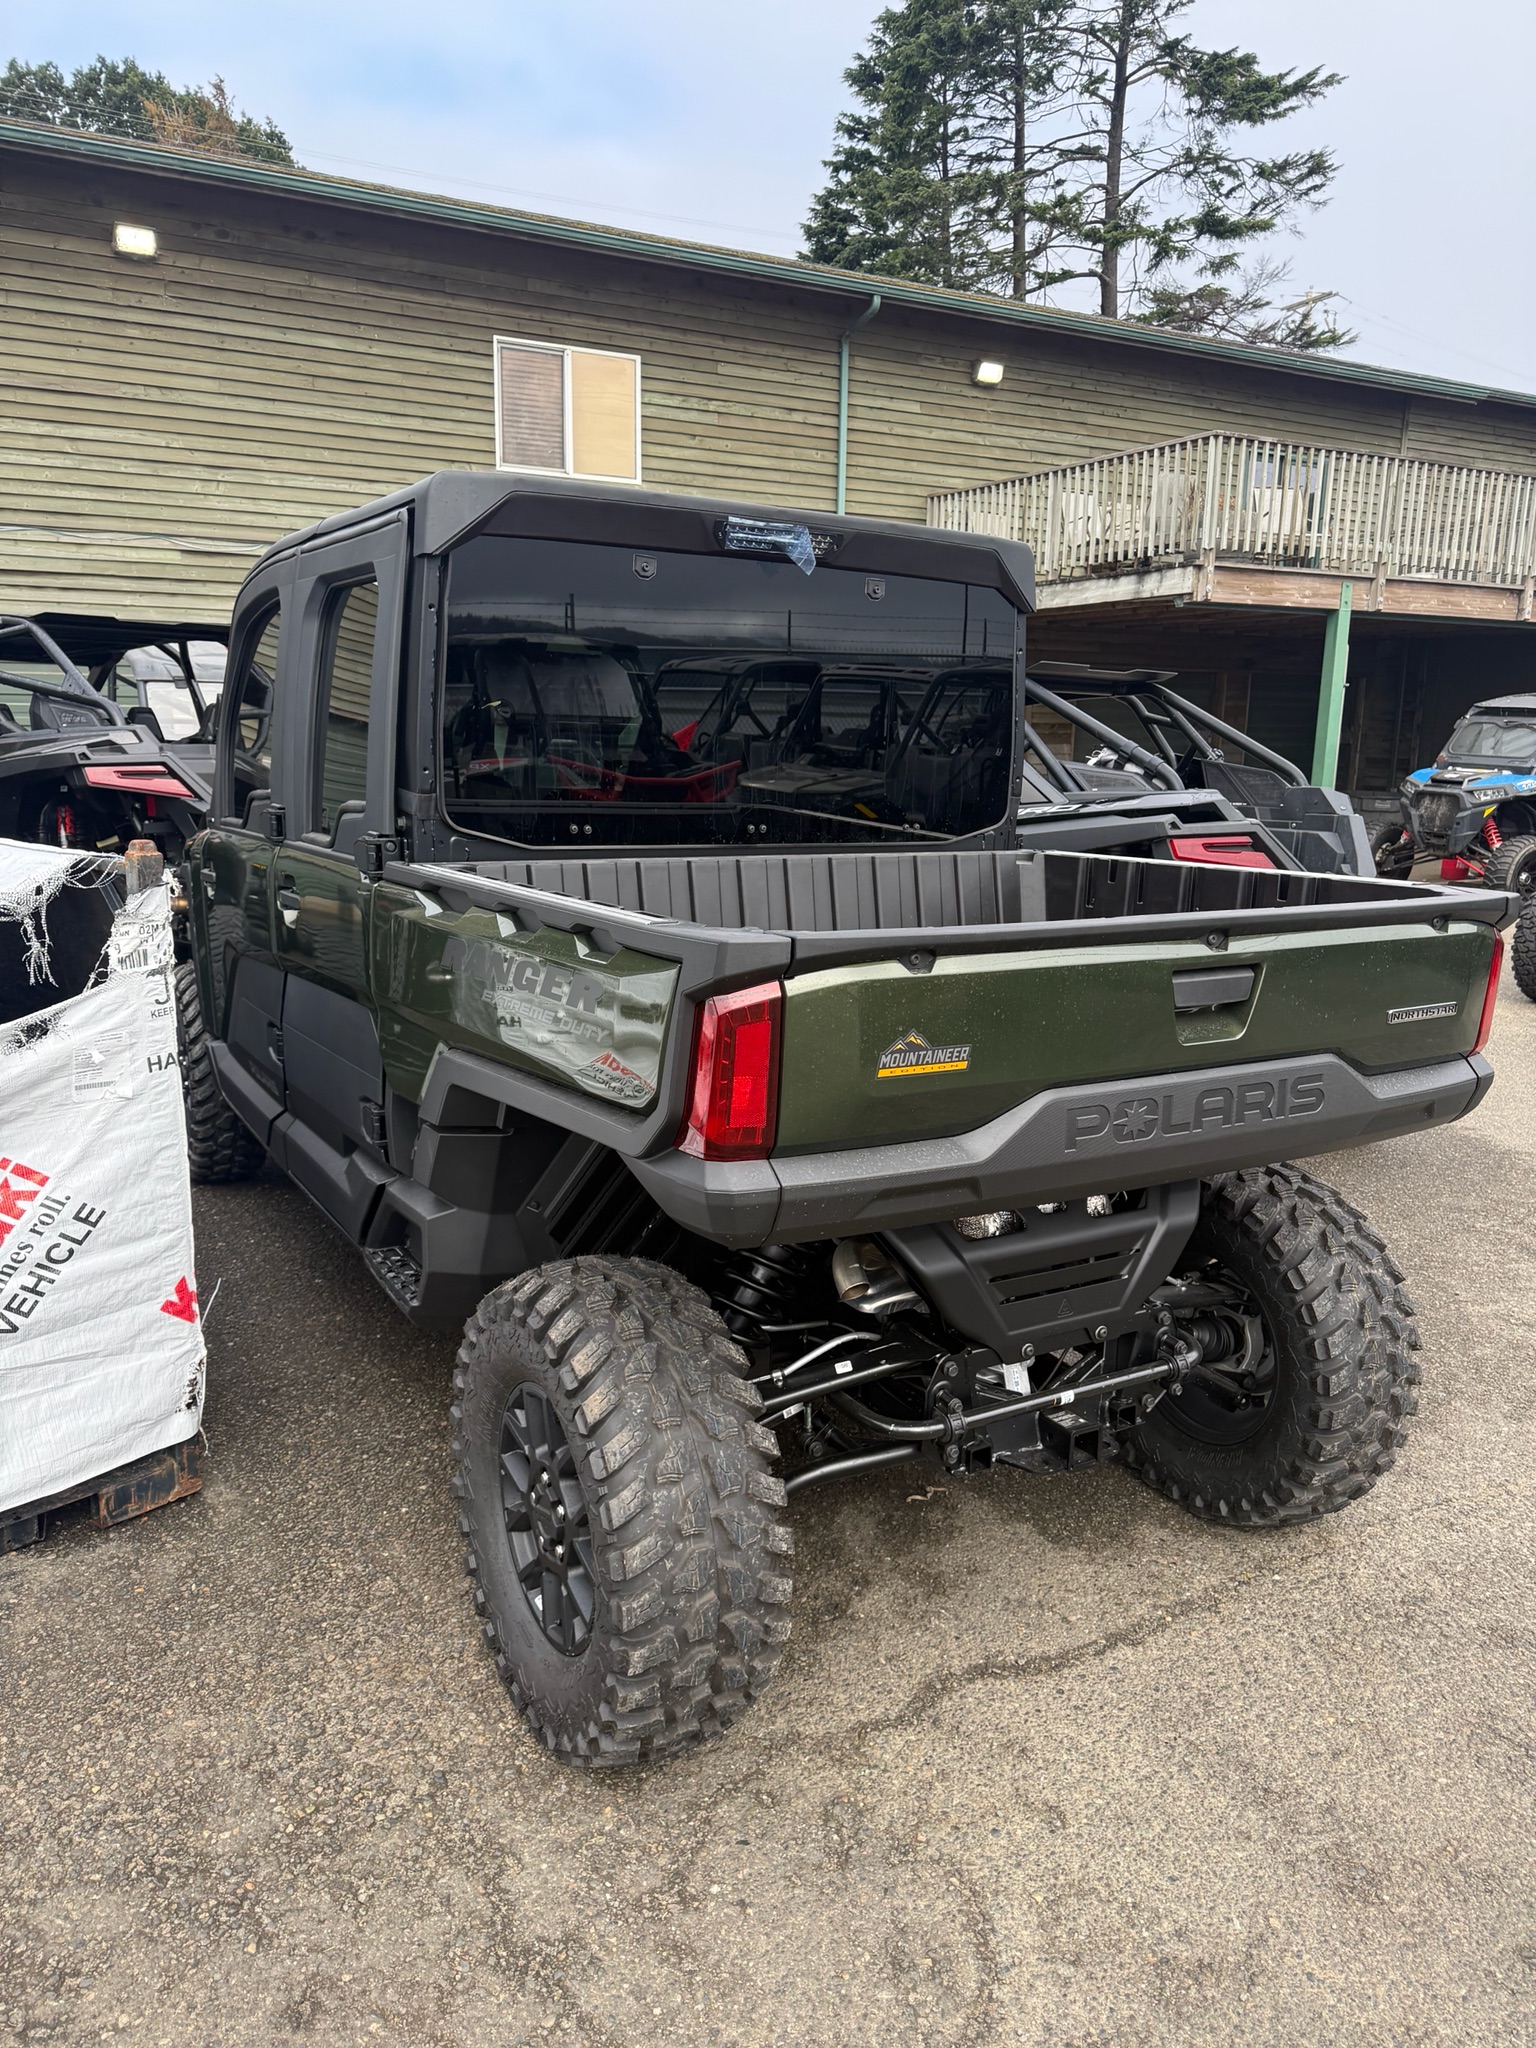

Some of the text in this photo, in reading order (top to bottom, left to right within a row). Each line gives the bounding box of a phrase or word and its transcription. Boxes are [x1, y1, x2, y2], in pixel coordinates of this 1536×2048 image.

[439, 936, 605, 1016] RANGER
[481, 989, 611, 1043] EXTREME DUTY
[1393, 1005, 1455, 1021] NORTHSTAR
[880, 1046, 970, 1069] MOUNTAINEER
[1064, 1073, 1326, 1154] POLARIS
[29, 1194, 71, 1238] roll.
[0, 1202, 107, 1334] VEHICLE
